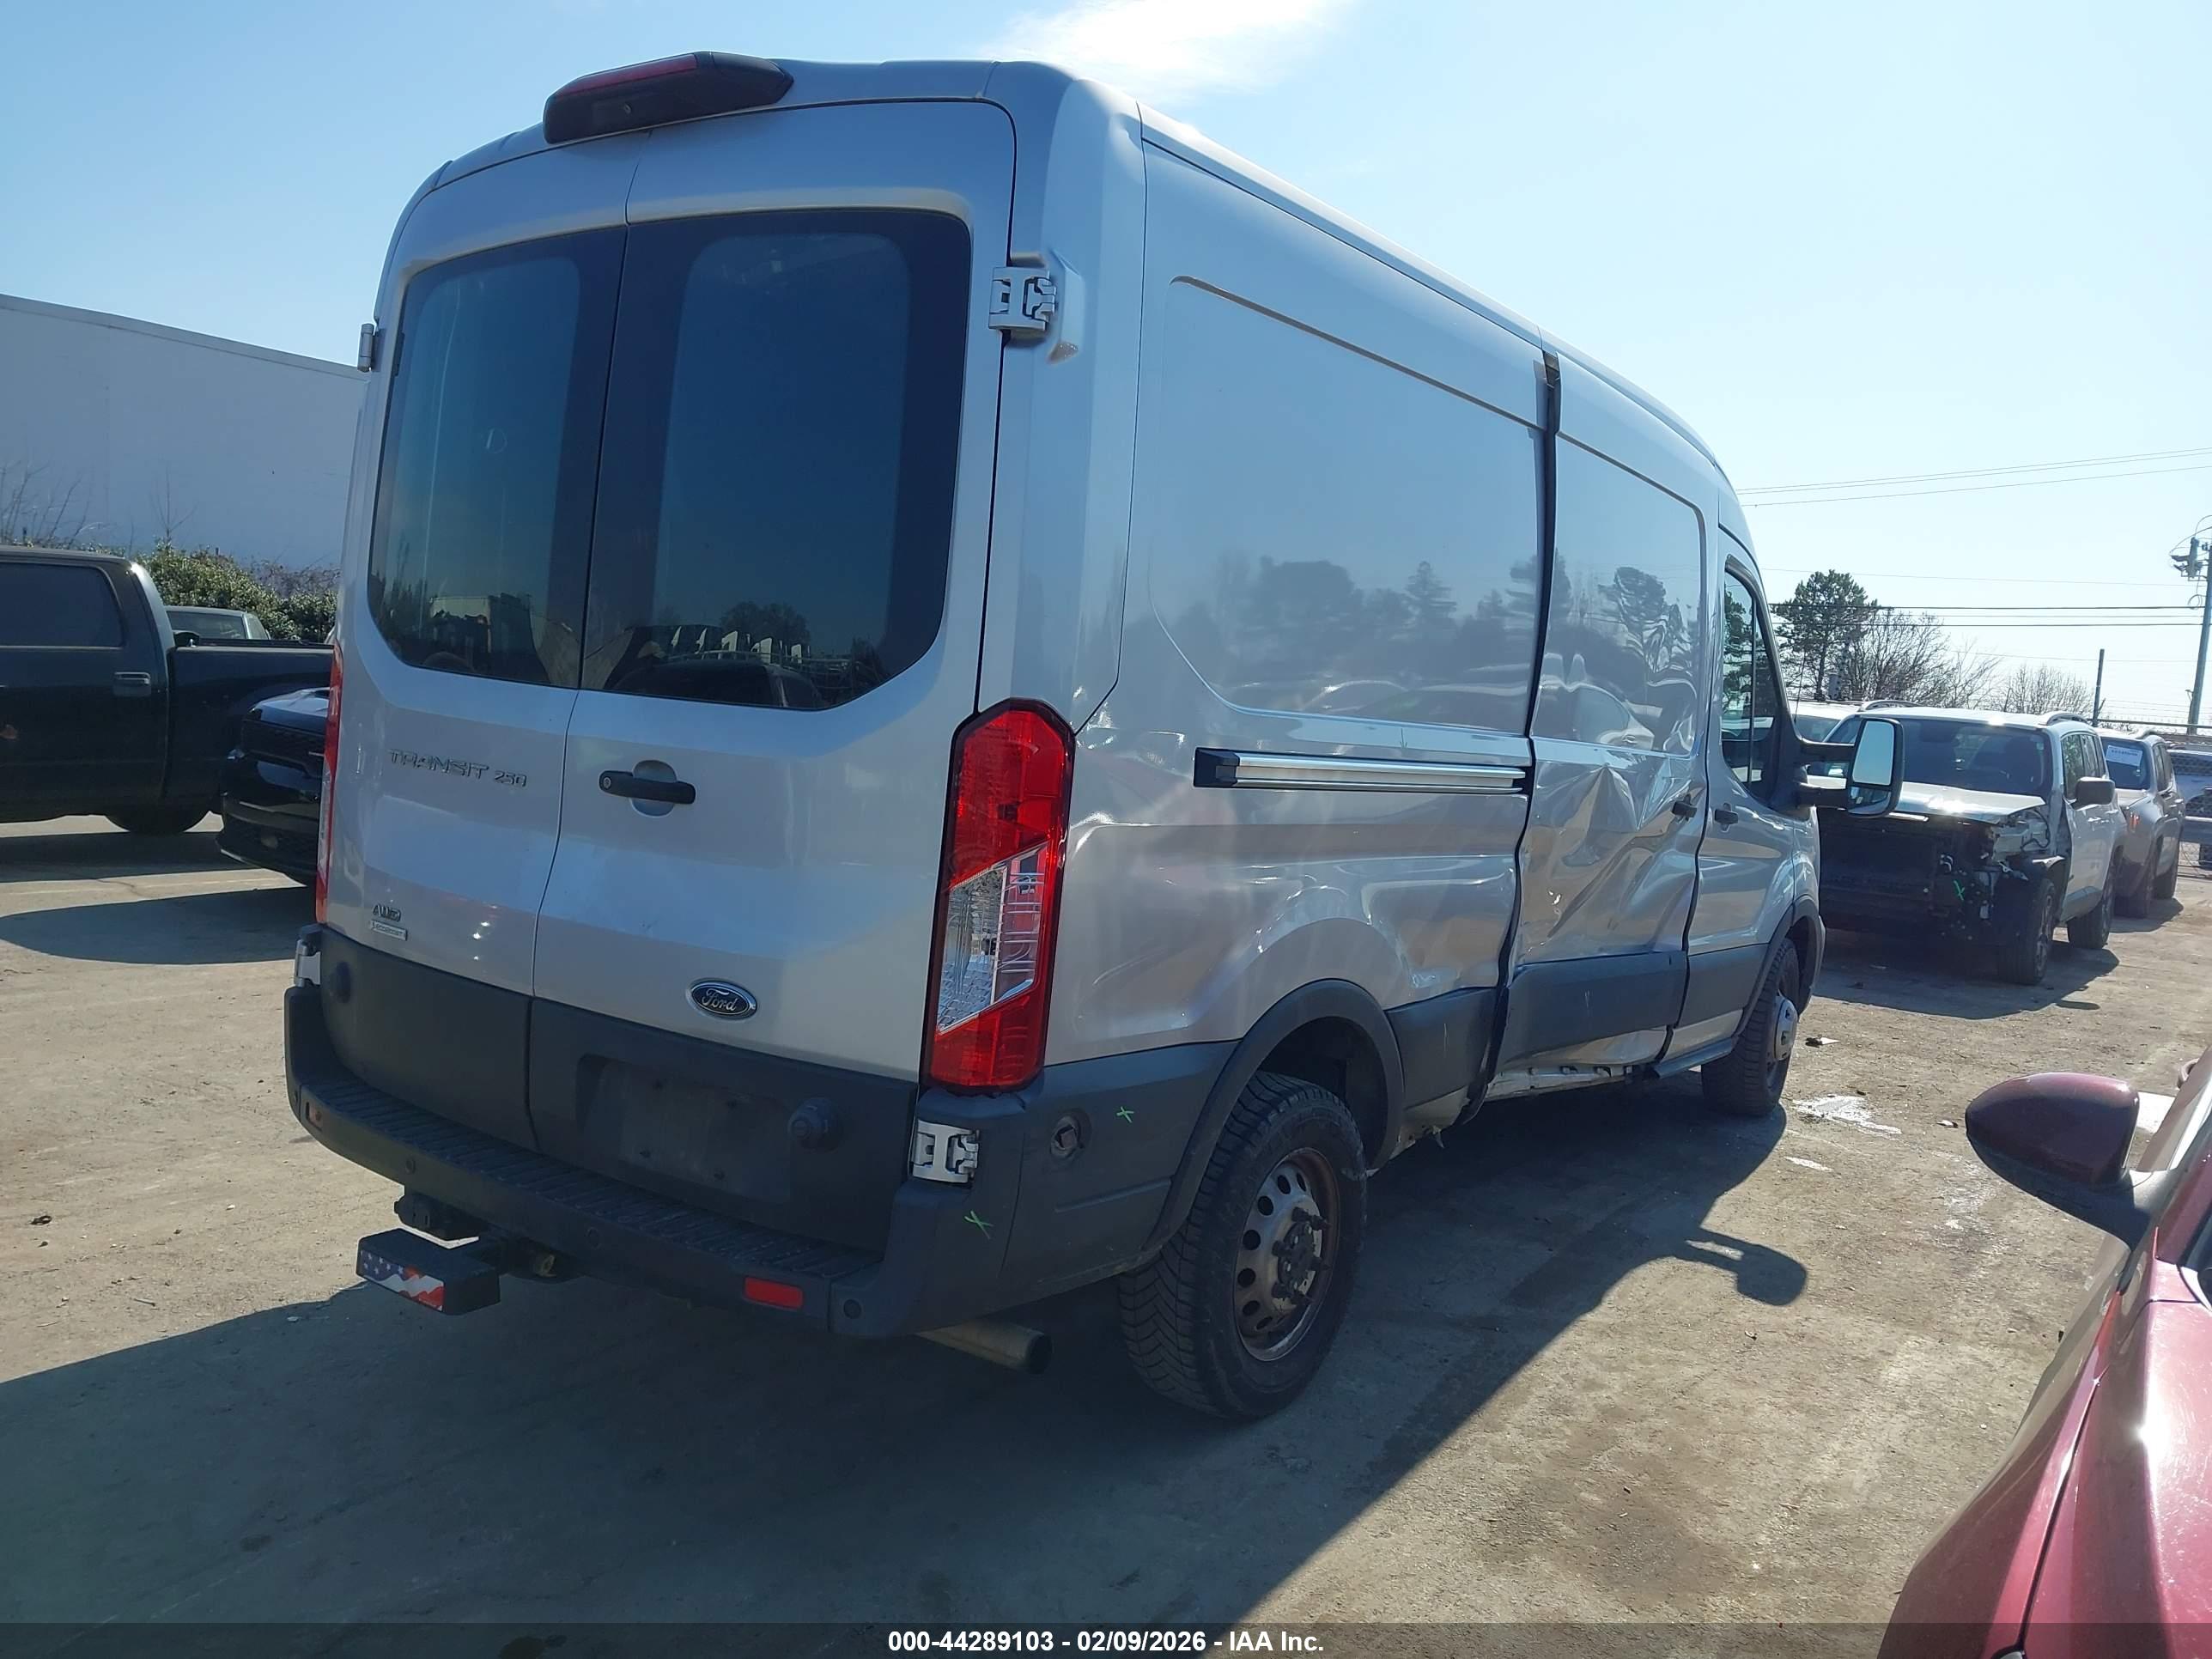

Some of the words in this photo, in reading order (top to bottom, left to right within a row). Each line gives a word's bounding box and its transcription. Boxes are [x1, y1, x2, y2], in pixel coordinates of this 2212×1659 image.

[389, 748, 490, 779] TRANSIT
[494, 769, 527, 787] 250
[702, 988, 738, 1012] Ford
